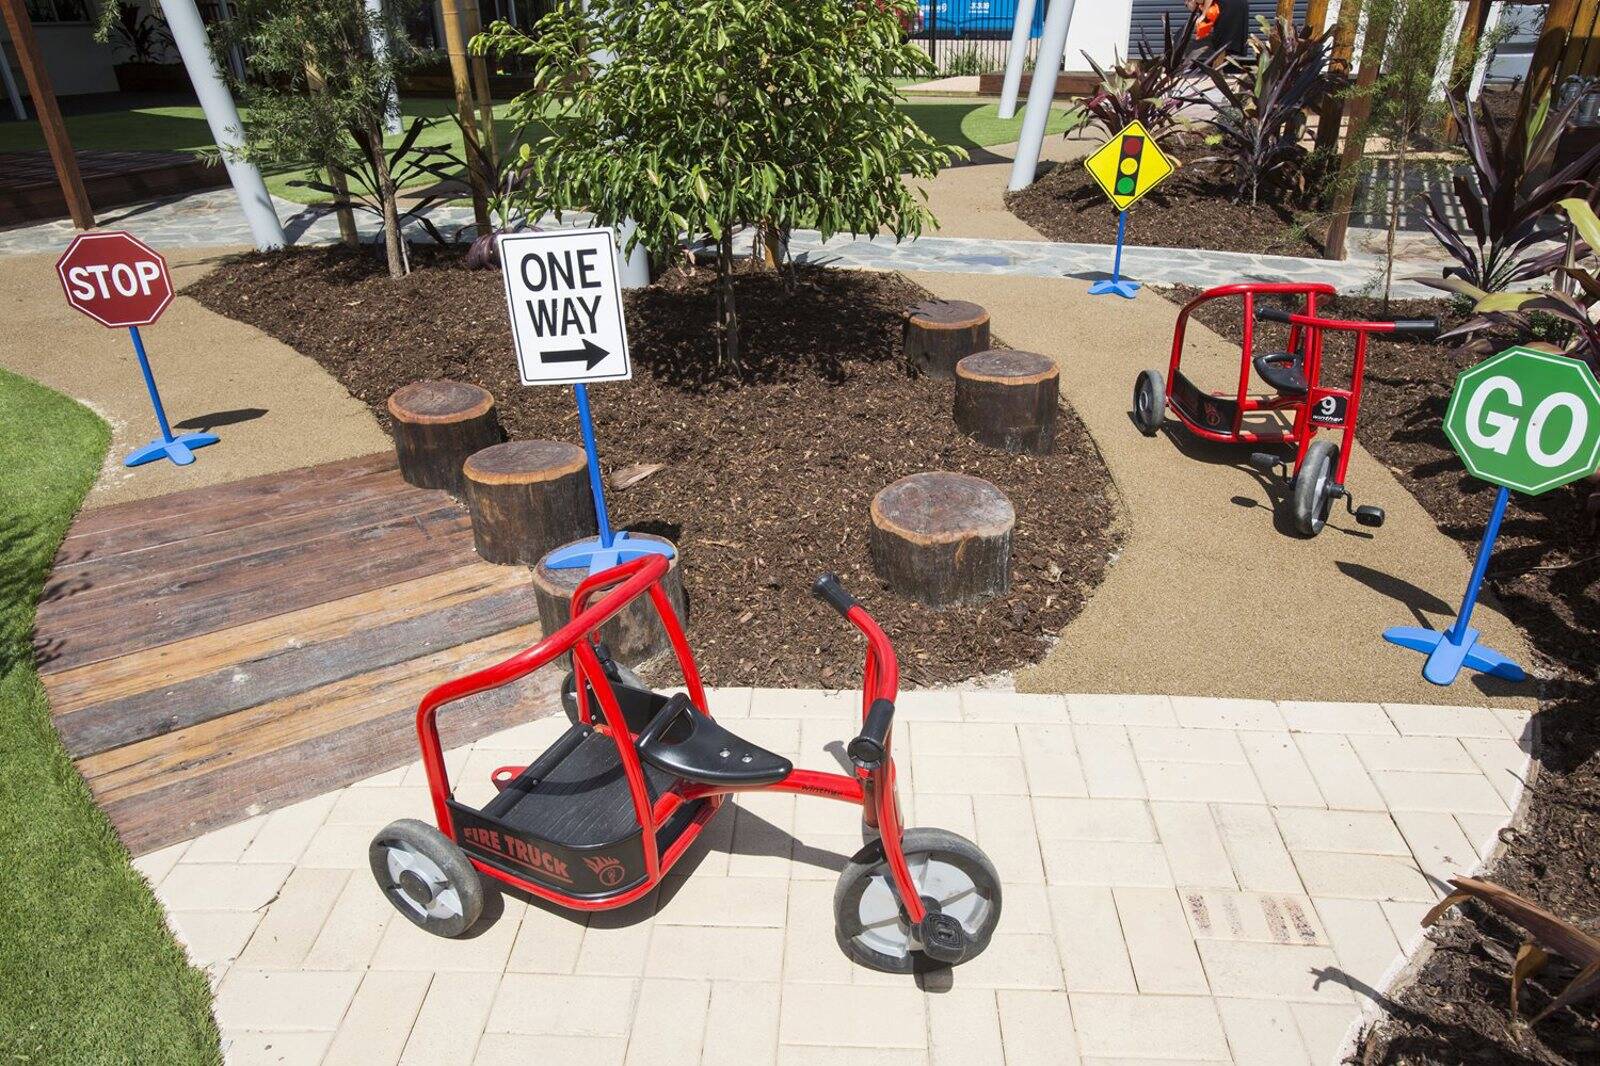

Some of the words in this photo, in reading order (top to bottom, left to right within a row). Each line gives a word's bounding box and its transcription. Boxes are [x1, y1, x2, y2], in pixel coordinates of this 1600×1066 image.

[68, 260, 160, 301] STOP
[520, 248, 602, 292] ONE
[525, 295, 602, 337] WAY
[1321, 396, 1336, 415] 9
[1465, 375, 1588, 468] GO
[463, 827, 501, 849] FIRE
[504, 835, 570, 878] TRUCK
